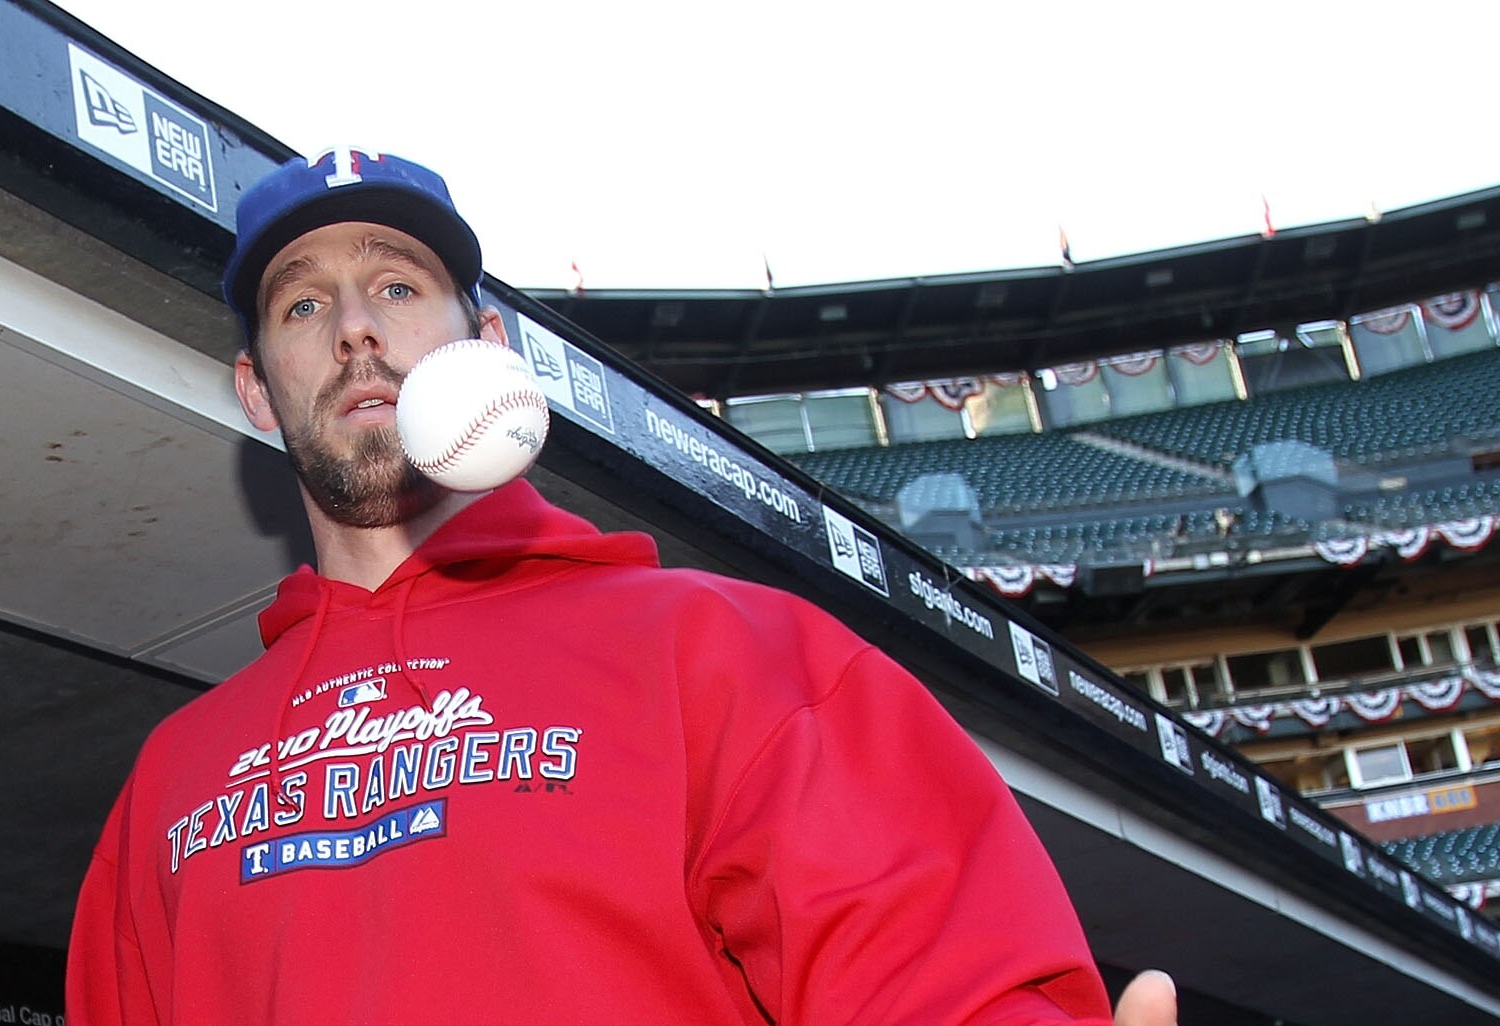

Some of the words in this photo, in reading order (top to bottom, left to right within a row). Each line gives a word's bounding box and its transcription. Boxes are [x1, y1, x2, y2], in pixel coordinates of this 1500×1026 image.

[152, 112, 201, 158] NEW
[155, 139, 206, 187] ERA
[307, 146, 386, 189] T
[570, 359, 602, 393] NEW
[574, 383, 606, 413] ERA
[645, 408, 802, 523] neweracap.com
[908, 571, 994, 639] sfgiants.com
[316, 668, 374, 695] AUTHENTIC
[320, 687, 493, 753] Playoffs
[167, 772, 306, 874] TEXAS
[324, 727, 581, 819] RANGERS
[246, 842, 268, 874] T
[282, 818, 403, 864] BASEBALL
